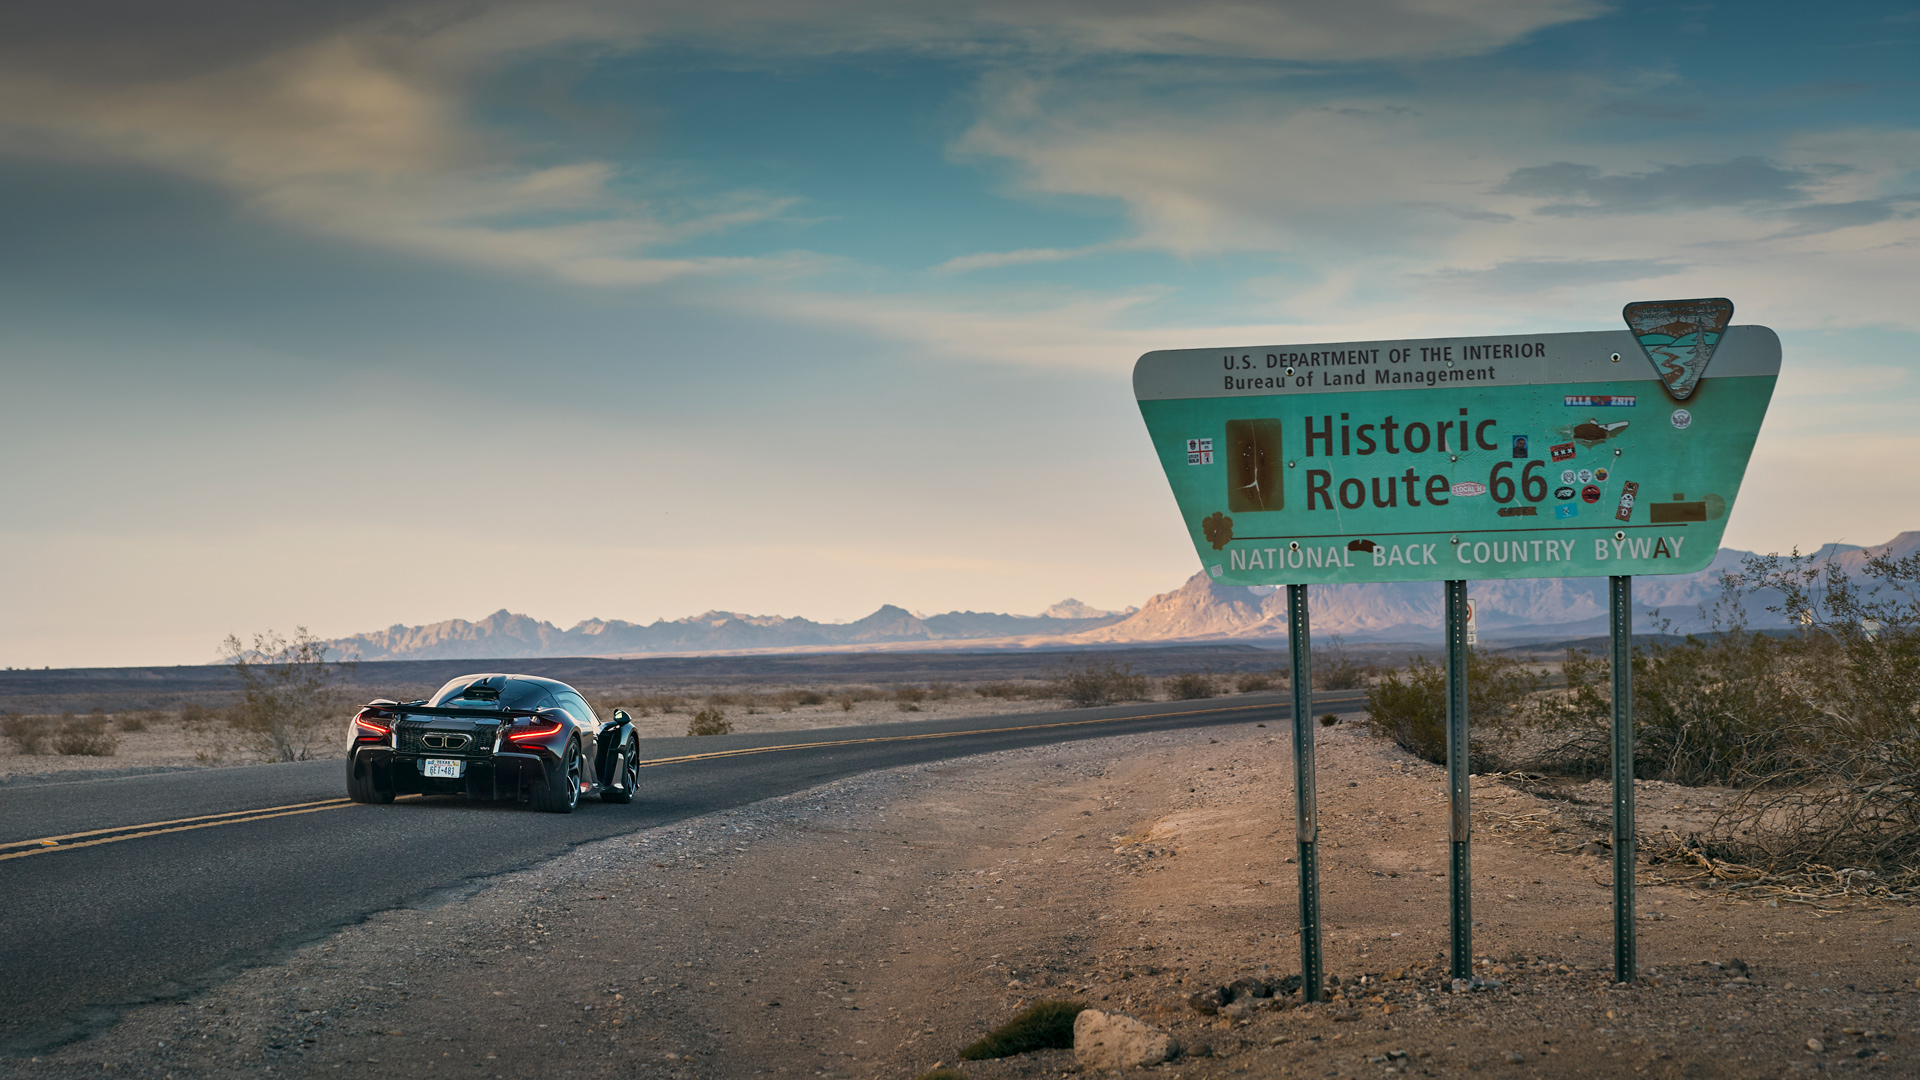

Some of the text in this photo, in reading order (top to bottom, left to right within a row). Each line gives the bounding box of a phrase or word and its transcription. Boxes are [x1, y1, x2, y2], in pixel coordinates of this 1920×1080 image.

[1224, 342, 1545, 370] U.S. DEPARTMENT OF THE INTERIOR
[1224, 366, 1495, 390] Bureau of Land Management
[1305, 408, 1498, 457] Historic
[1306, 460, 1548, 511] Route 66
[1230, 536, 1685, 571] NATIONAL BACK COUNTRY BYWAY
